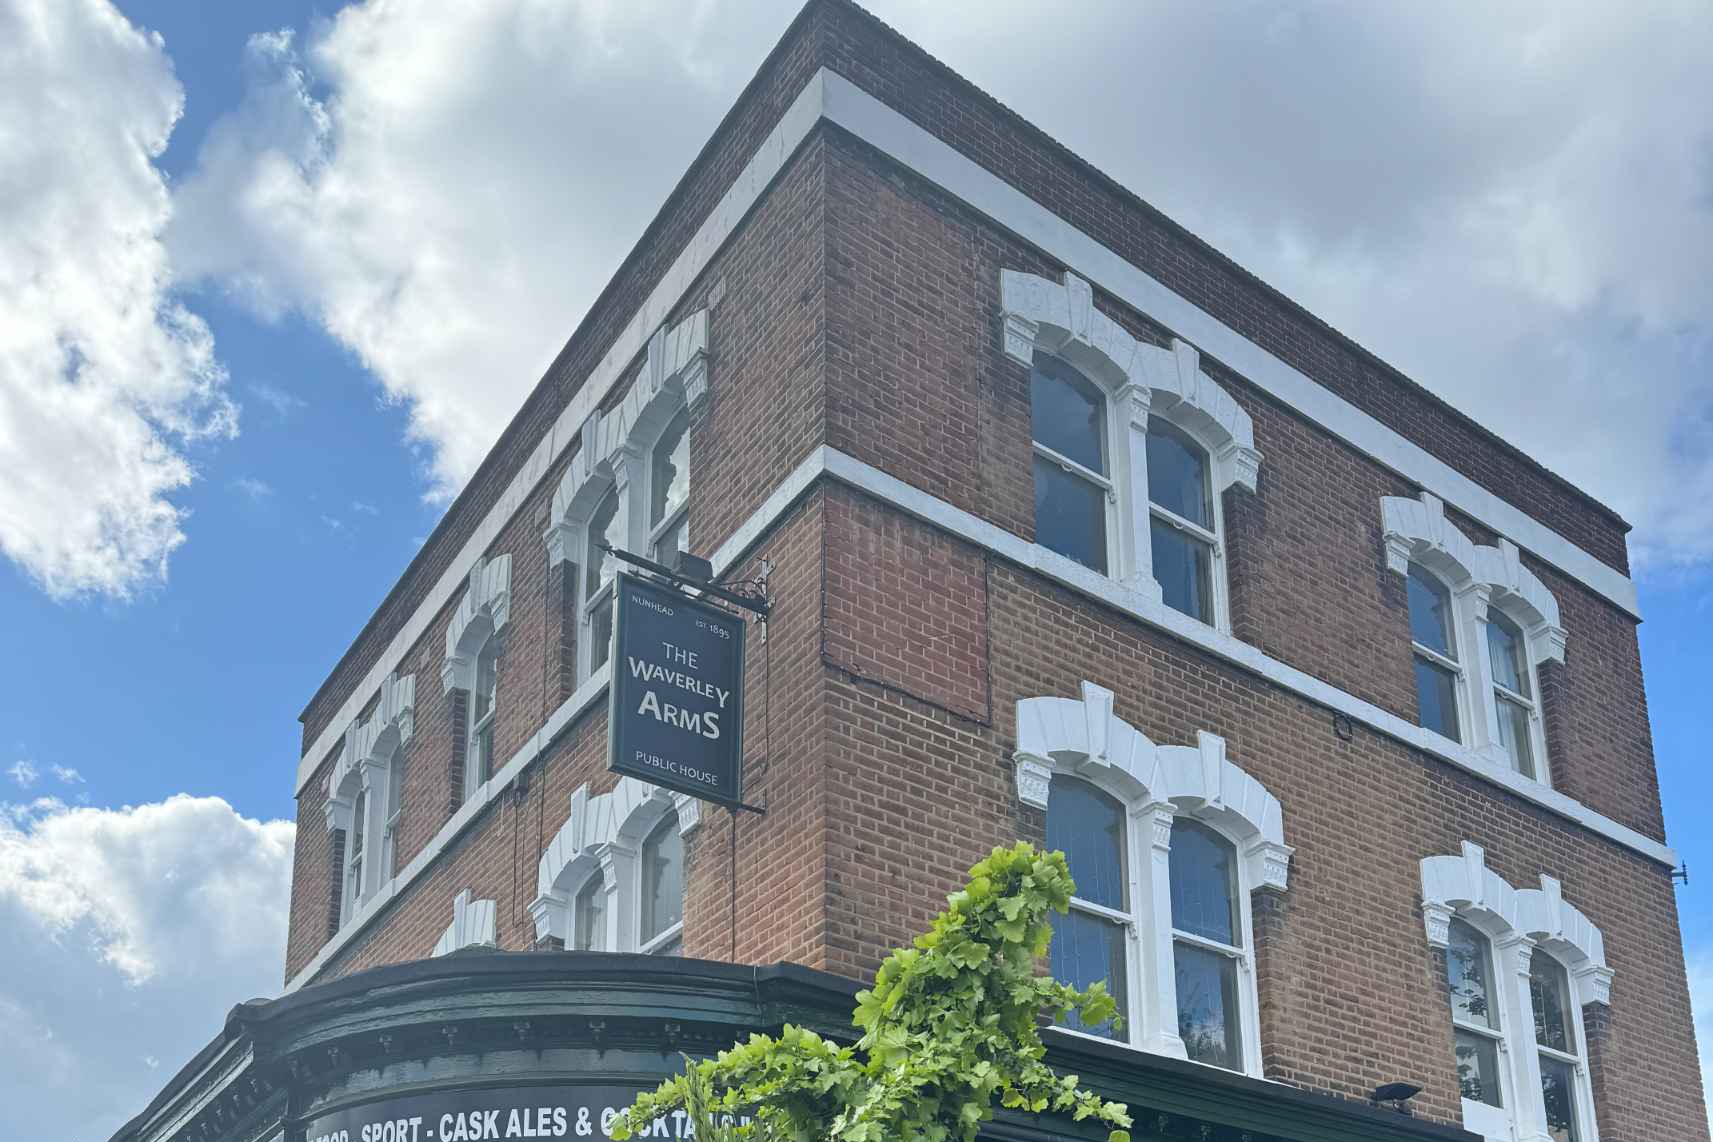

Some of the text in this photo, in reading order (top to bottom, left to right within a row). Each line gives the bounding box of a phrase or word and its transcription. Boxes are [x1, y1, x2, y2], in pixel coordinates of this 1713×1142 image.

[632, 594, 675, 617] NUNHEAD
[709, 624, 730, 640] 1895
[662, 641, 699, 669] THE
[627, 656, 730, 709] WAVERLEY
[637, 690, 720, 740] ARMS
[635, 750, 719, 786] PUBLIC HOUSE
[439, 1110, 500, 1142] CASK
[505, 1106, 567, 1138] ALES
[575, 1106, 593, 1137] &
